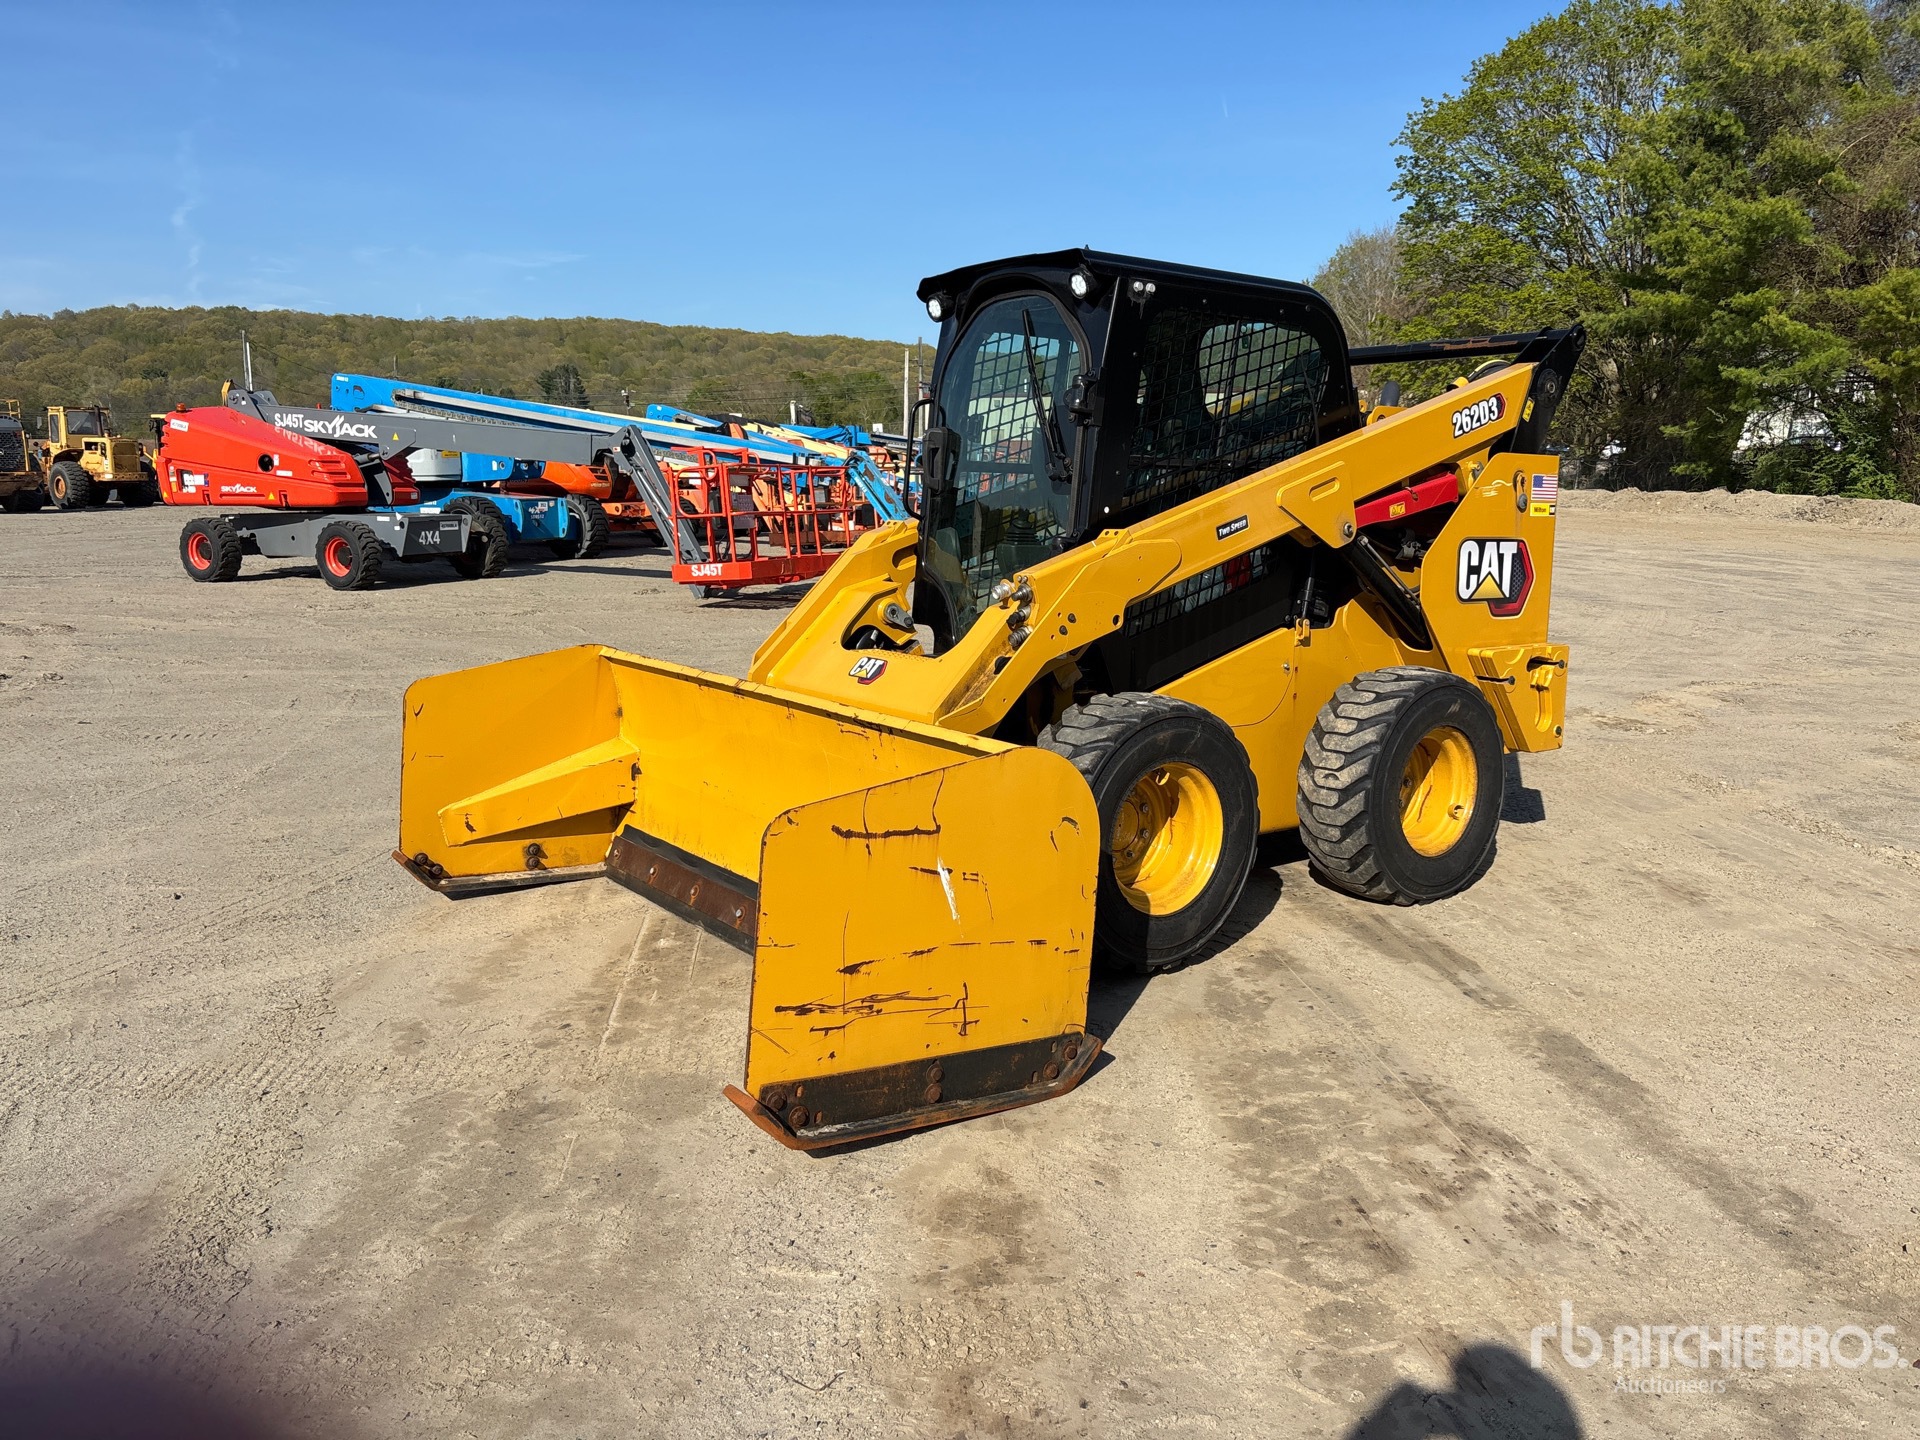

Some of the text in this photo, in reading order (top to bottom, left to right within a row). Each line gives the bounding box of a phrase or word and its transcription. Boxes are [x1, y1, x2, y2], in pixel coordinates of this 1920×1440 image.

[274, 413, 378, 439] SJ45T SKYJACK
[1452, 396, 1499, 437] 262D3
[221, 484, 257, 493] SKYJACK
[419, 530, 441, 545] 4X4
[691, 563, 723, 577] SJ45T
[1458, 540, 1518, 599] CAT
[849, 656, 885, 678] CAT
